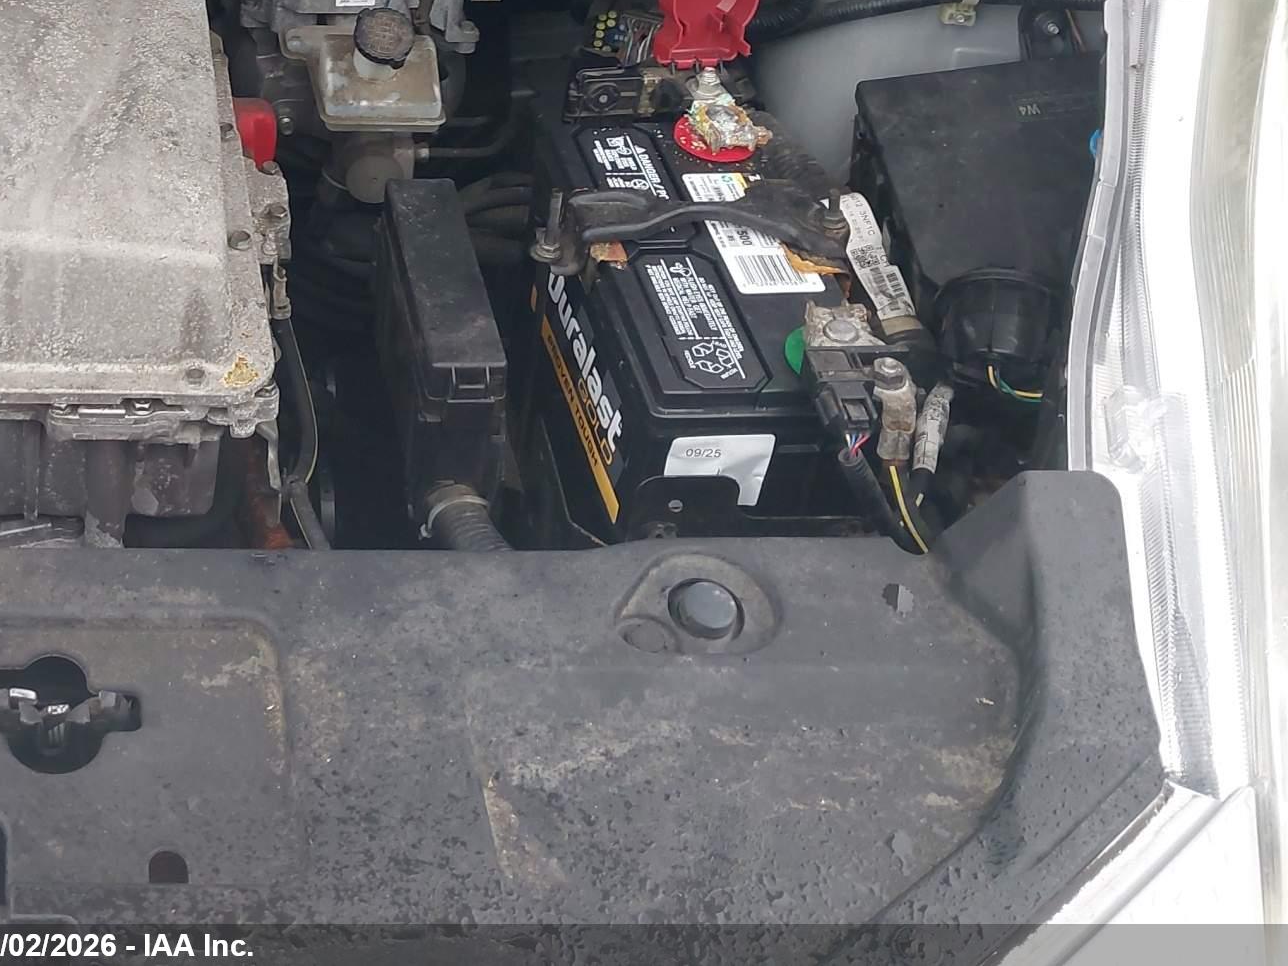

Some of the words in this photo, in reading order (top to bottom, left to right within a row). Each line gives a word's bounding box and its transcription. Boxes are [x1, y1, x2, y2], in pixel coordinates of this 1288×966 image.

[638, 153, 661, 185] DANGER
[736, 230, 752, 246] 500
[680, 295, 692, 306] HELP
[693, 291, 704, 301] EYES
[577, 377, 613, 466] GOLD
[574, 407, 599, 467] TOUGH
[685, 448, 722, 458] 09/25
